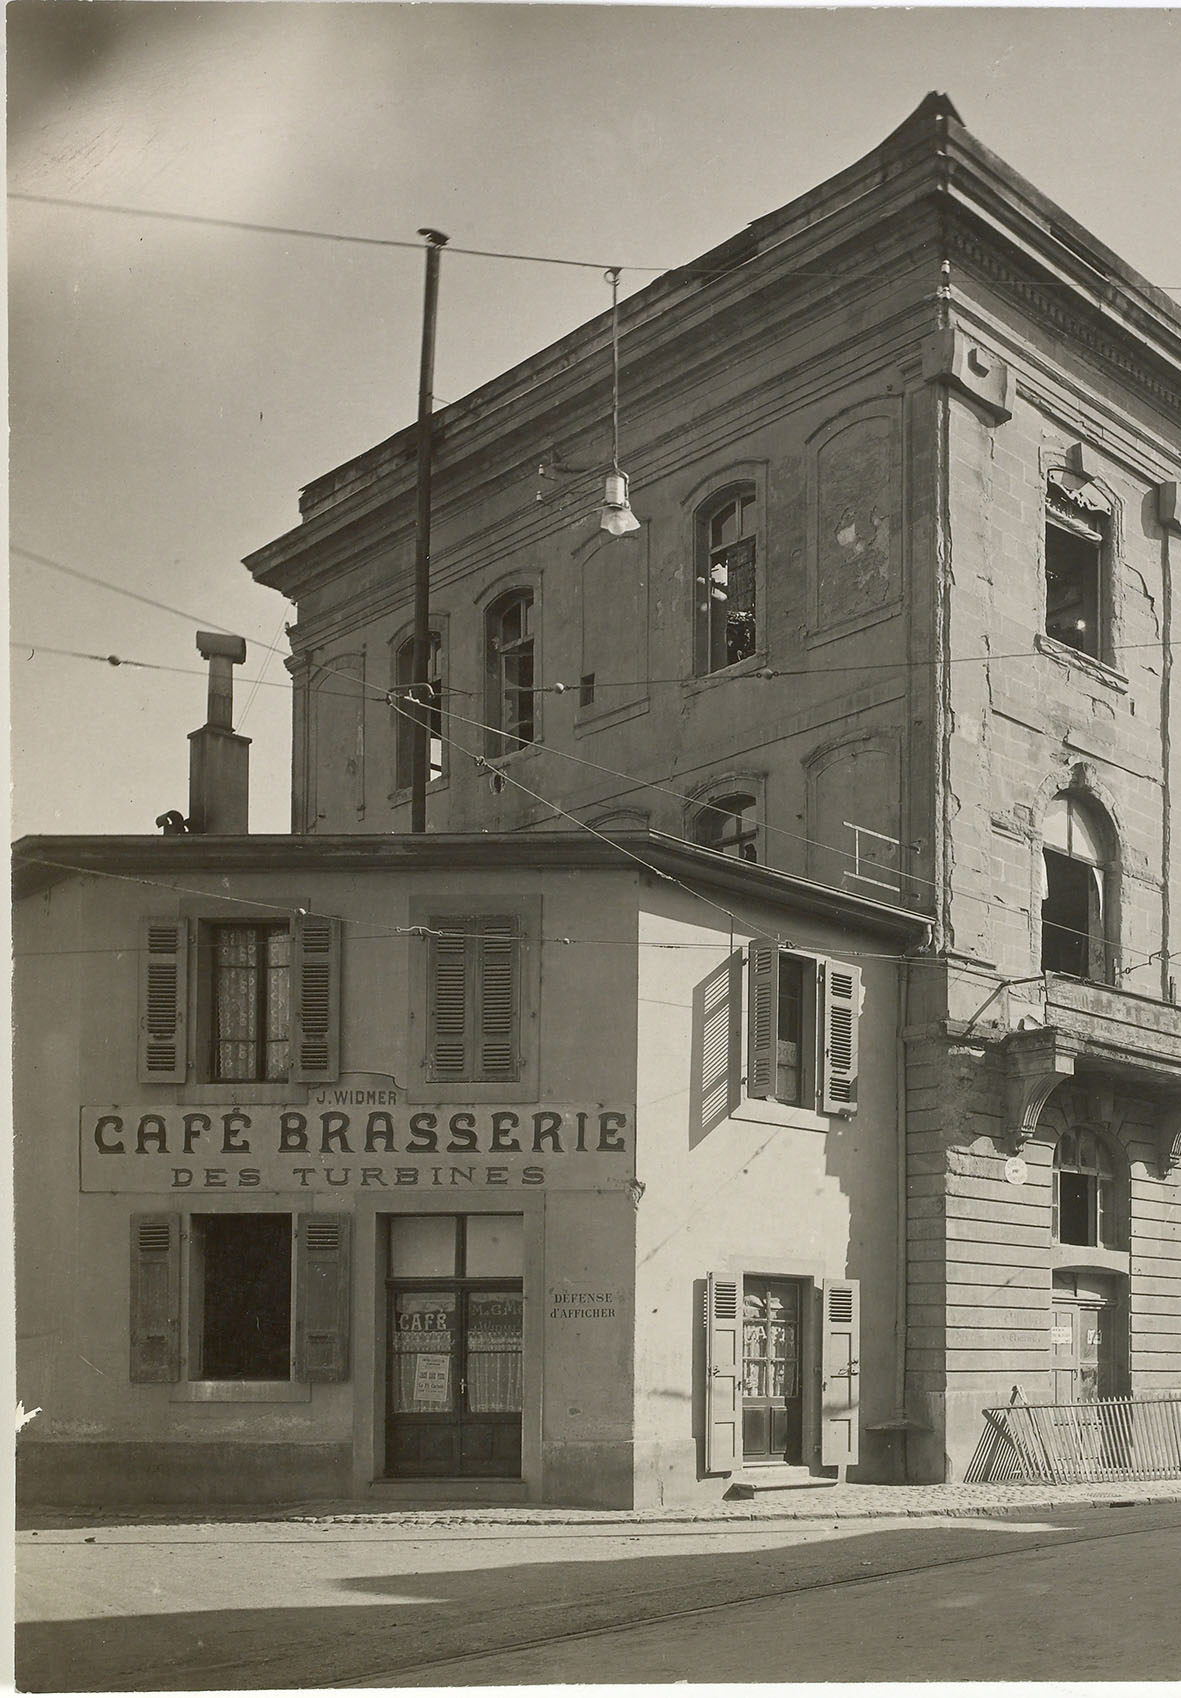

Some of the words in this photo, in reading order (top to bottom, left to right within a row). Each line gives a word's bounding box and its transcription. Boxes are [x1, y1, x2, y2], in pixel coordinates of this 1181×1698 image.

[94, 1107, 252, 1154] CAFÉ
[277, 1111, 627, 1153] BRASSERIE
[170, 1168, 261, 1187] DES
[292, 1167, 545, 1187] TURBINES
[554, 1289, 613, 1303] DÉFENSE
[399, 1309, 448, 1330] CAFÉ
[550, 1307, 616, 1319] d'AFFICHER
